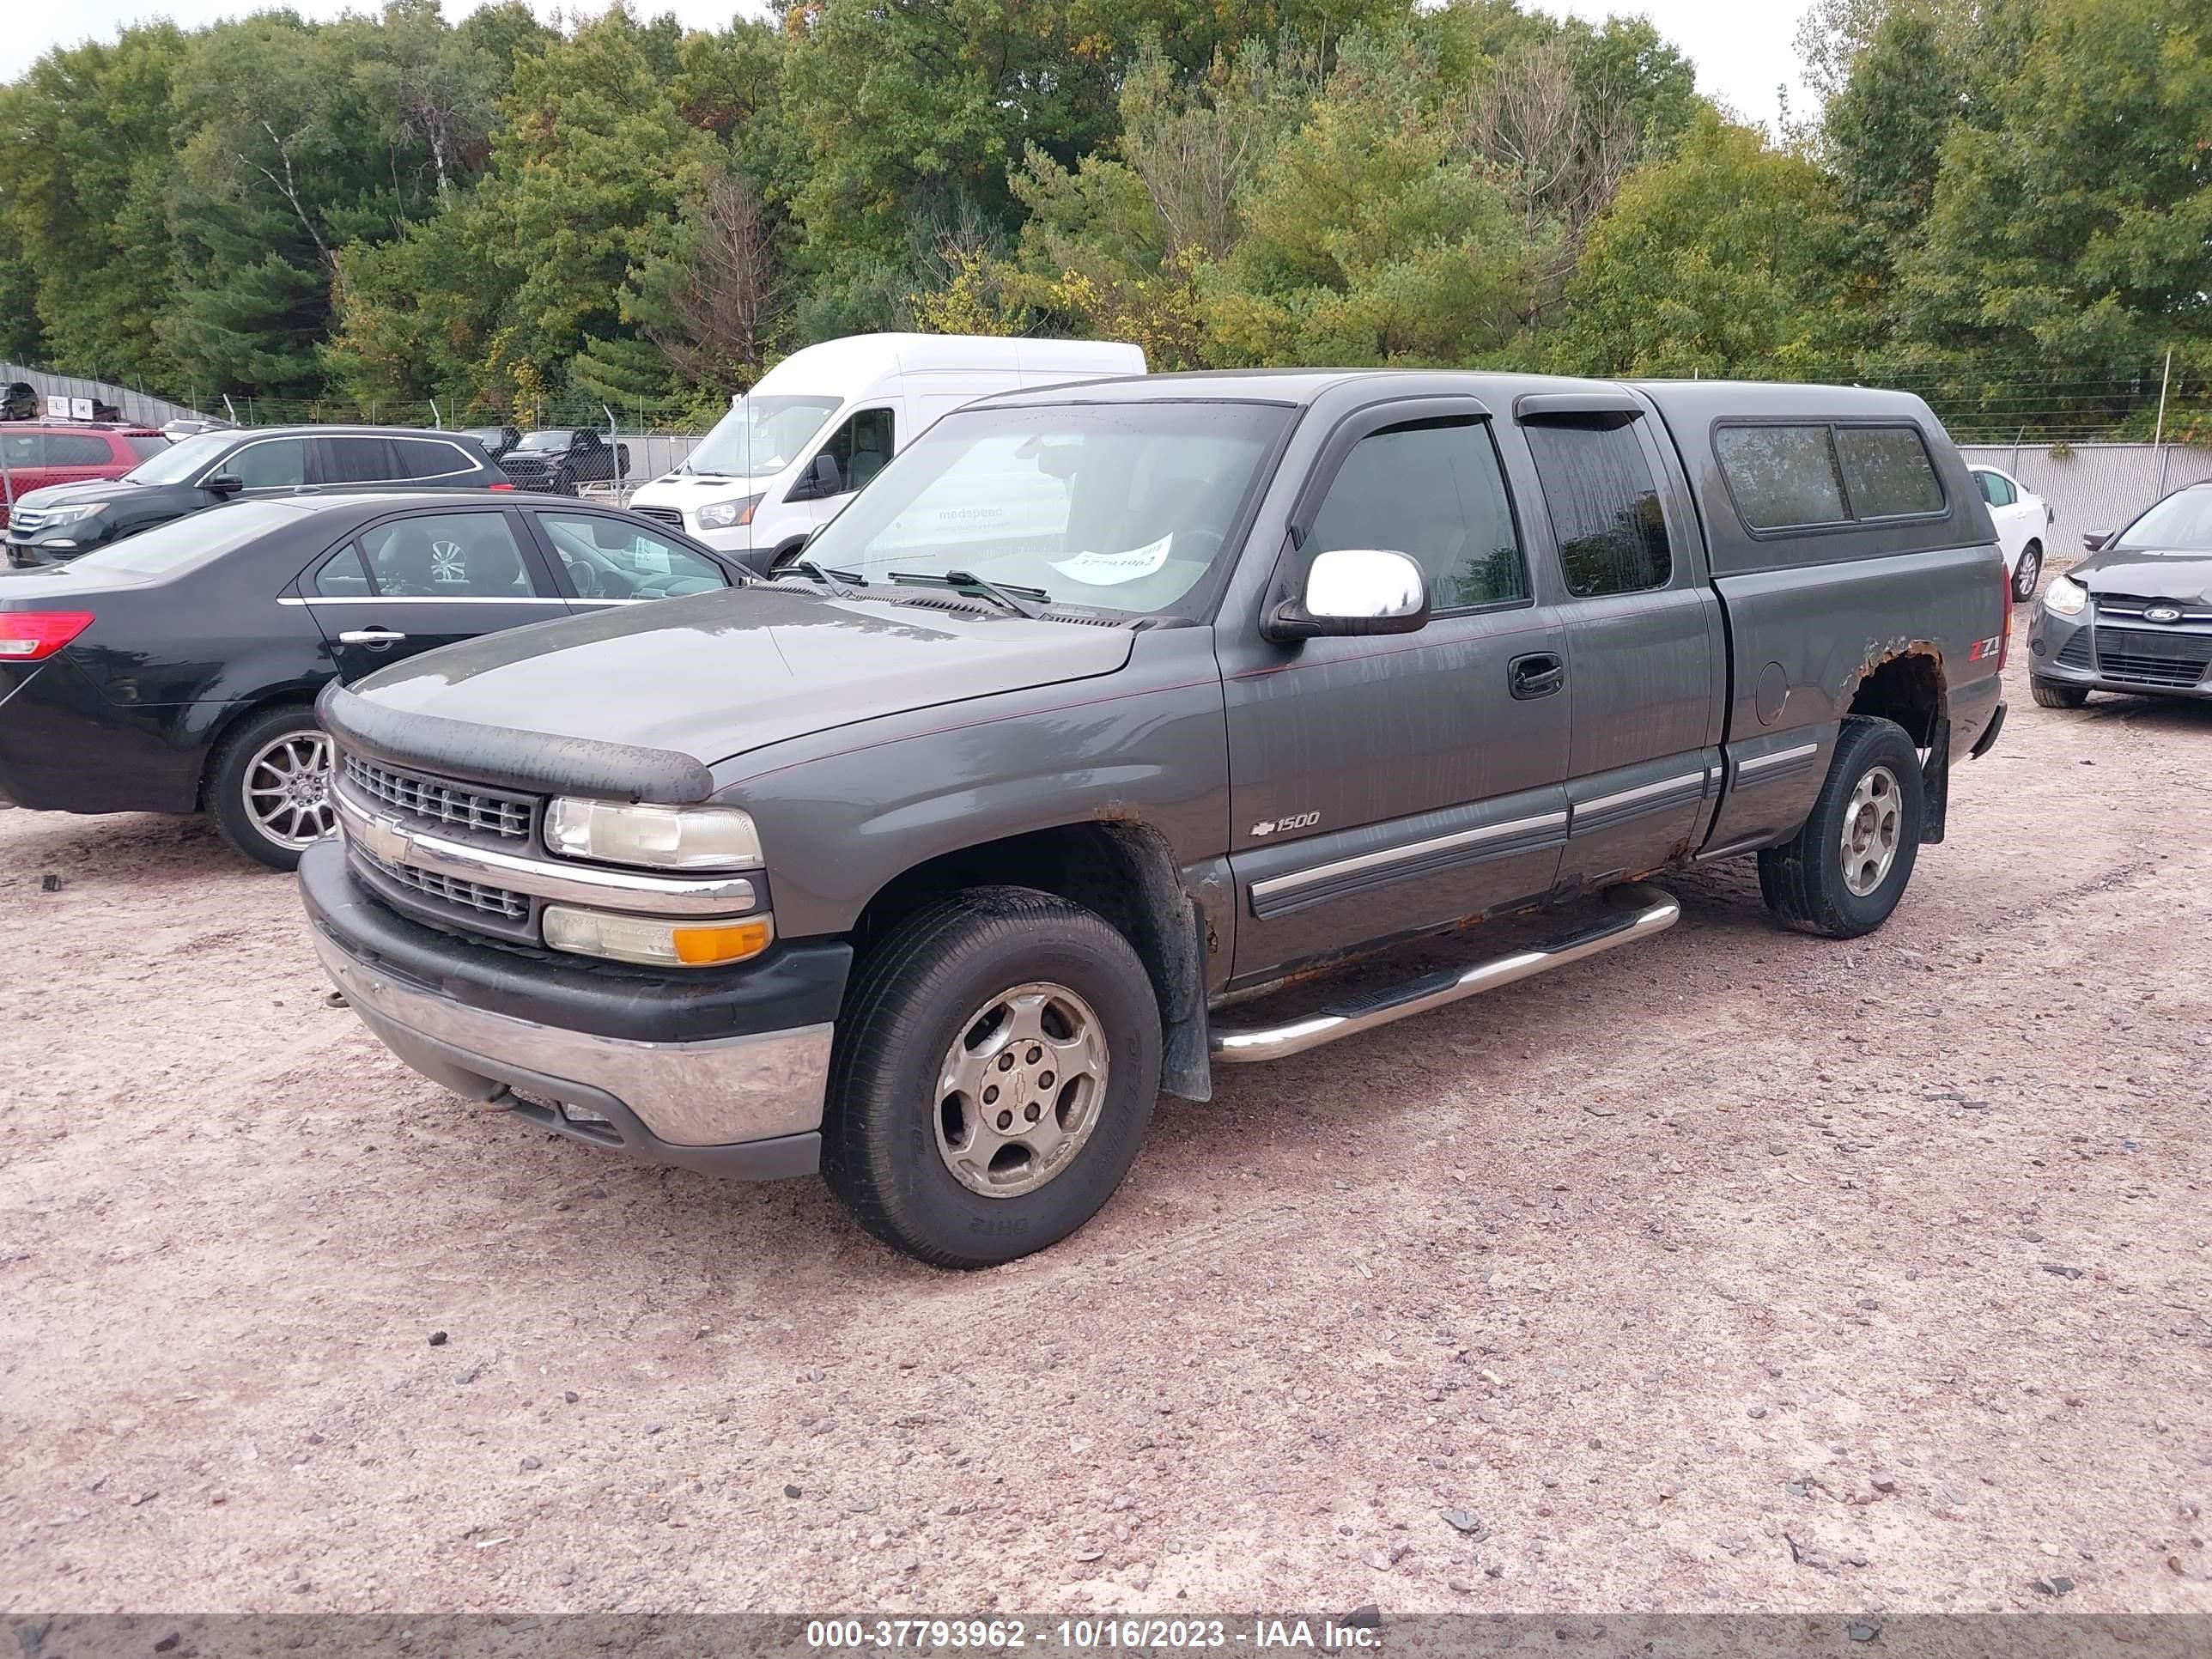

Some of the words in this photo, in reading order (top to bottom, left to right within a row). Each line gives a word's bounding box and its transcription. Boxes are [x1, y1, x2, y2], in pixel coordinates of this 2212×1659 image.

[939, 505, 1003, 520] medspeed
[1968, 635, 2000, 661] Z71
[1276, 811, 1321, 832] 1500
